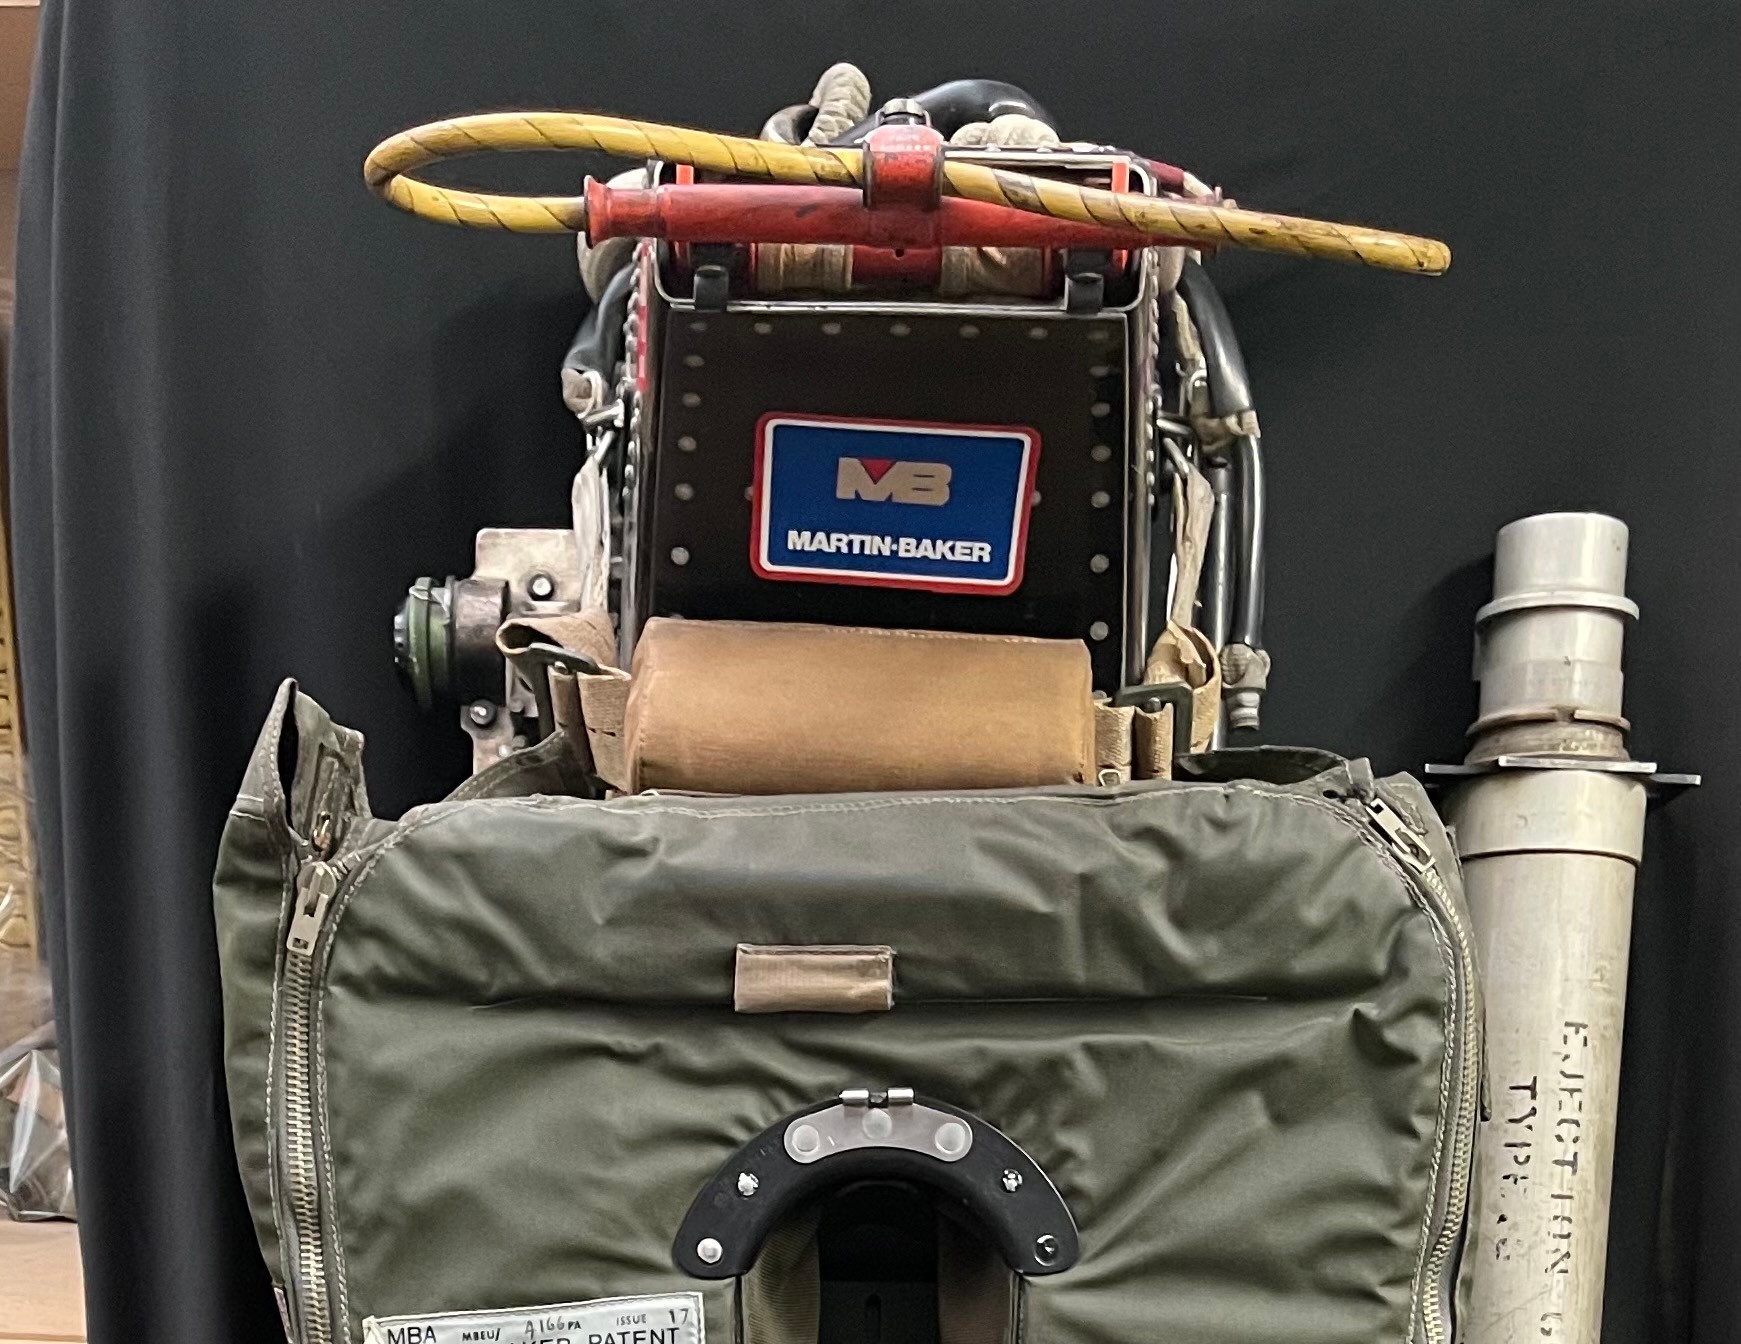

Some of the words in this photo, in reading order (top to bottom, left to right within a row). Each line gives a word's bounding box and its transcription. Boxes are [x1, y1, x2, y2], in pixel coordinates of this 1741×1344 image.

[836, 457, 952, 506] MB
[616, 1313, 647, 1326] ISSUE
[669, 1308, 689, 1326] 17
